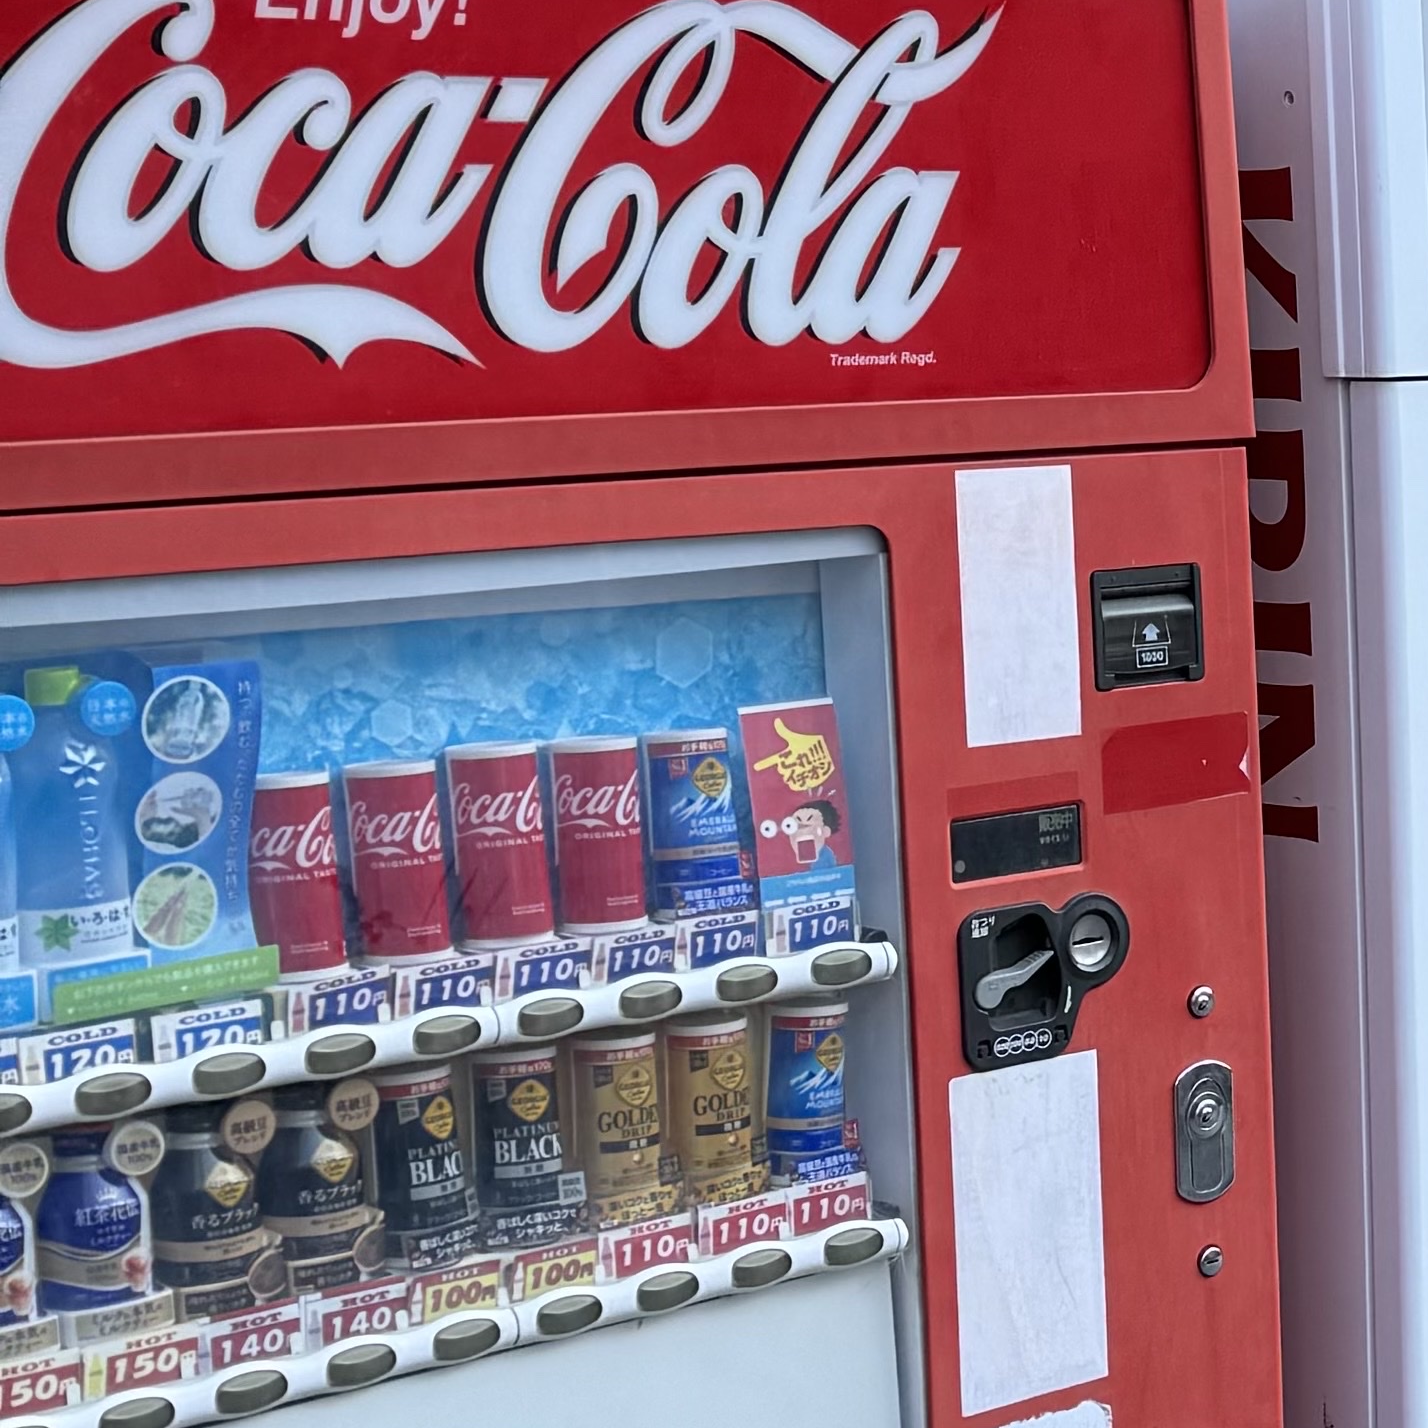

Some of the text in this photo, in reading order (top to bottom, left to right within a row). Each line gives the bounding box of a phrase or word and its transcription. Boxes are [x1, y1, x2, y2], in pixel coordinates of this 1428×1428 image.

[830, 352, 898, 367] Trademark
[778, 740, 827, 770] これ!!!
[793, 900, 840, 916] COLD
[694, 914, 745, 929] COLD
[793, 915, 849, 943] 110円
[615, 929, 666, 945] COLD
[696, 929, 755, 957] 110円
[520, 941, 579, 958] COLD
[614, 945, 673, 972] 110円
[419, 958, 481, 977] COLD
[314, 970, 377, 992] COLD
[179, 1006, 247, 1026] COLD
[48, 1026, 118, 1047] COLD
[597, 1104, 658, 1134] GOLDE
[716, 1107, 746, 1122] DRIP
[621, 1124, 654, 1139] DRIP
[494, 1132, 563, 1164] BLACK
[808, 1179, 849, 1194] HOT
[728, 1198, 768, 1214] HOT
[801, 1194, 864, 1223] 110円
[629, 1219, 673, 1234] HOT
[542, 1245, 581, 1260] HOT
[622, 1234, 690, 1266] 110円
[441, 1266, 482, 1282] HOT
[532, 1258, 594, 1290] 100円
[341, 1290, 391, 1308] HOT
[431, 1280, 496, 1312] 100円
[231, 1312, 282, 1331] HOT
[126, 1333, 177, 1349] HOT
[1, 1356, 56, 1376] HOT
